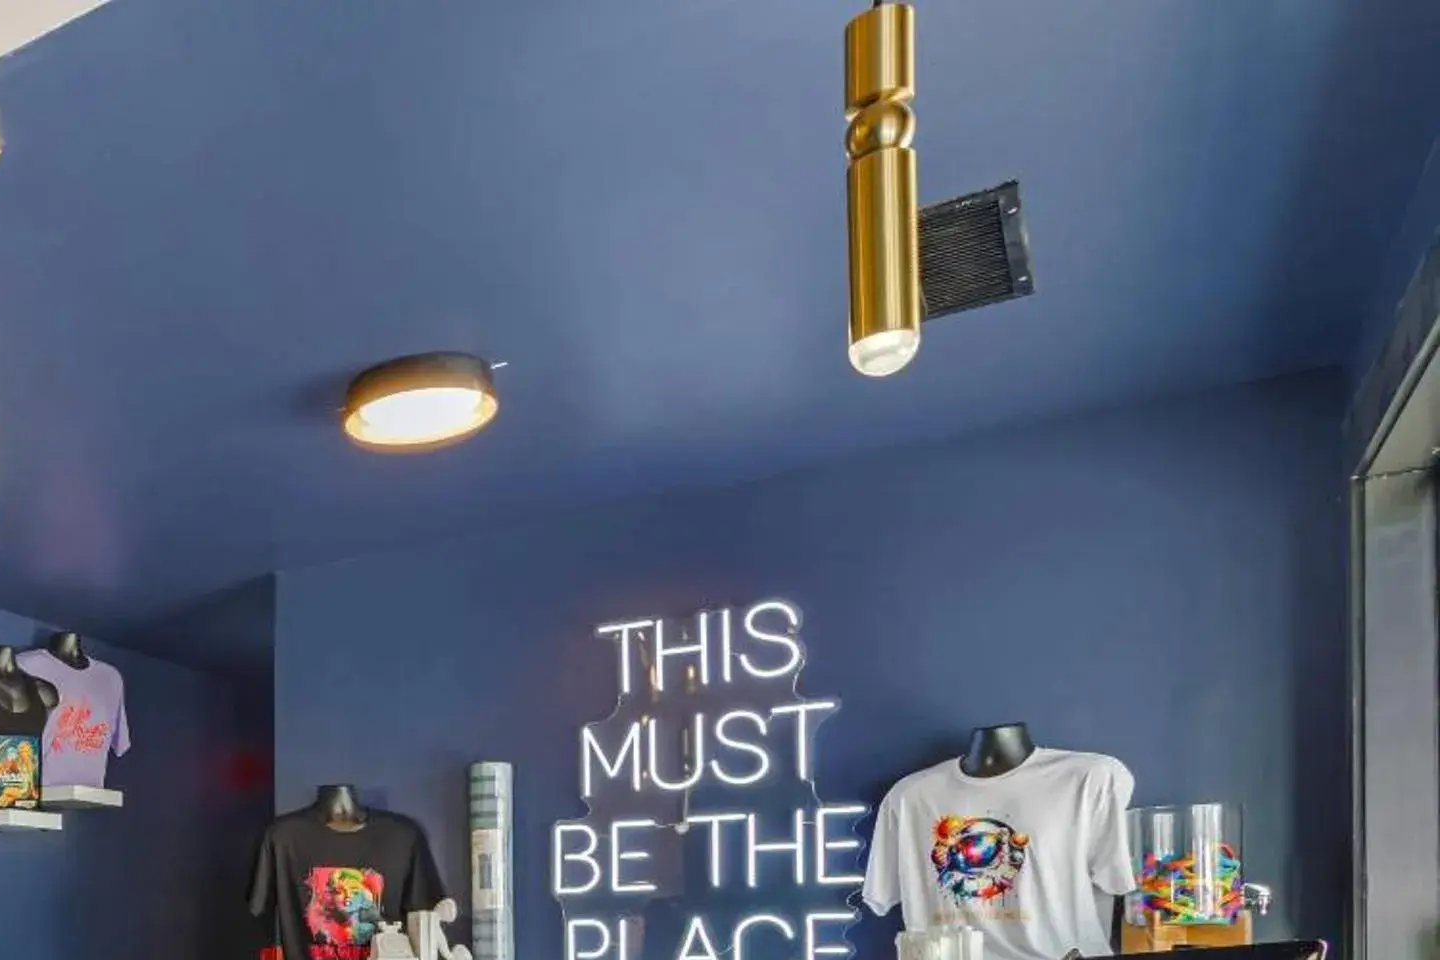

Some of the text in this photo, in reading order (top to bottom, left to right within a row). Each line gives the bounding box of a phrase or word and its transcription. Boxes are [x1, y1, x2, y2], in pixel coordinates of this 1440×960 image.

[597, 601, 801, 694] THIS
[581, 701, 837, 798] MUST
[553, 804, 866, 896] BE THE
